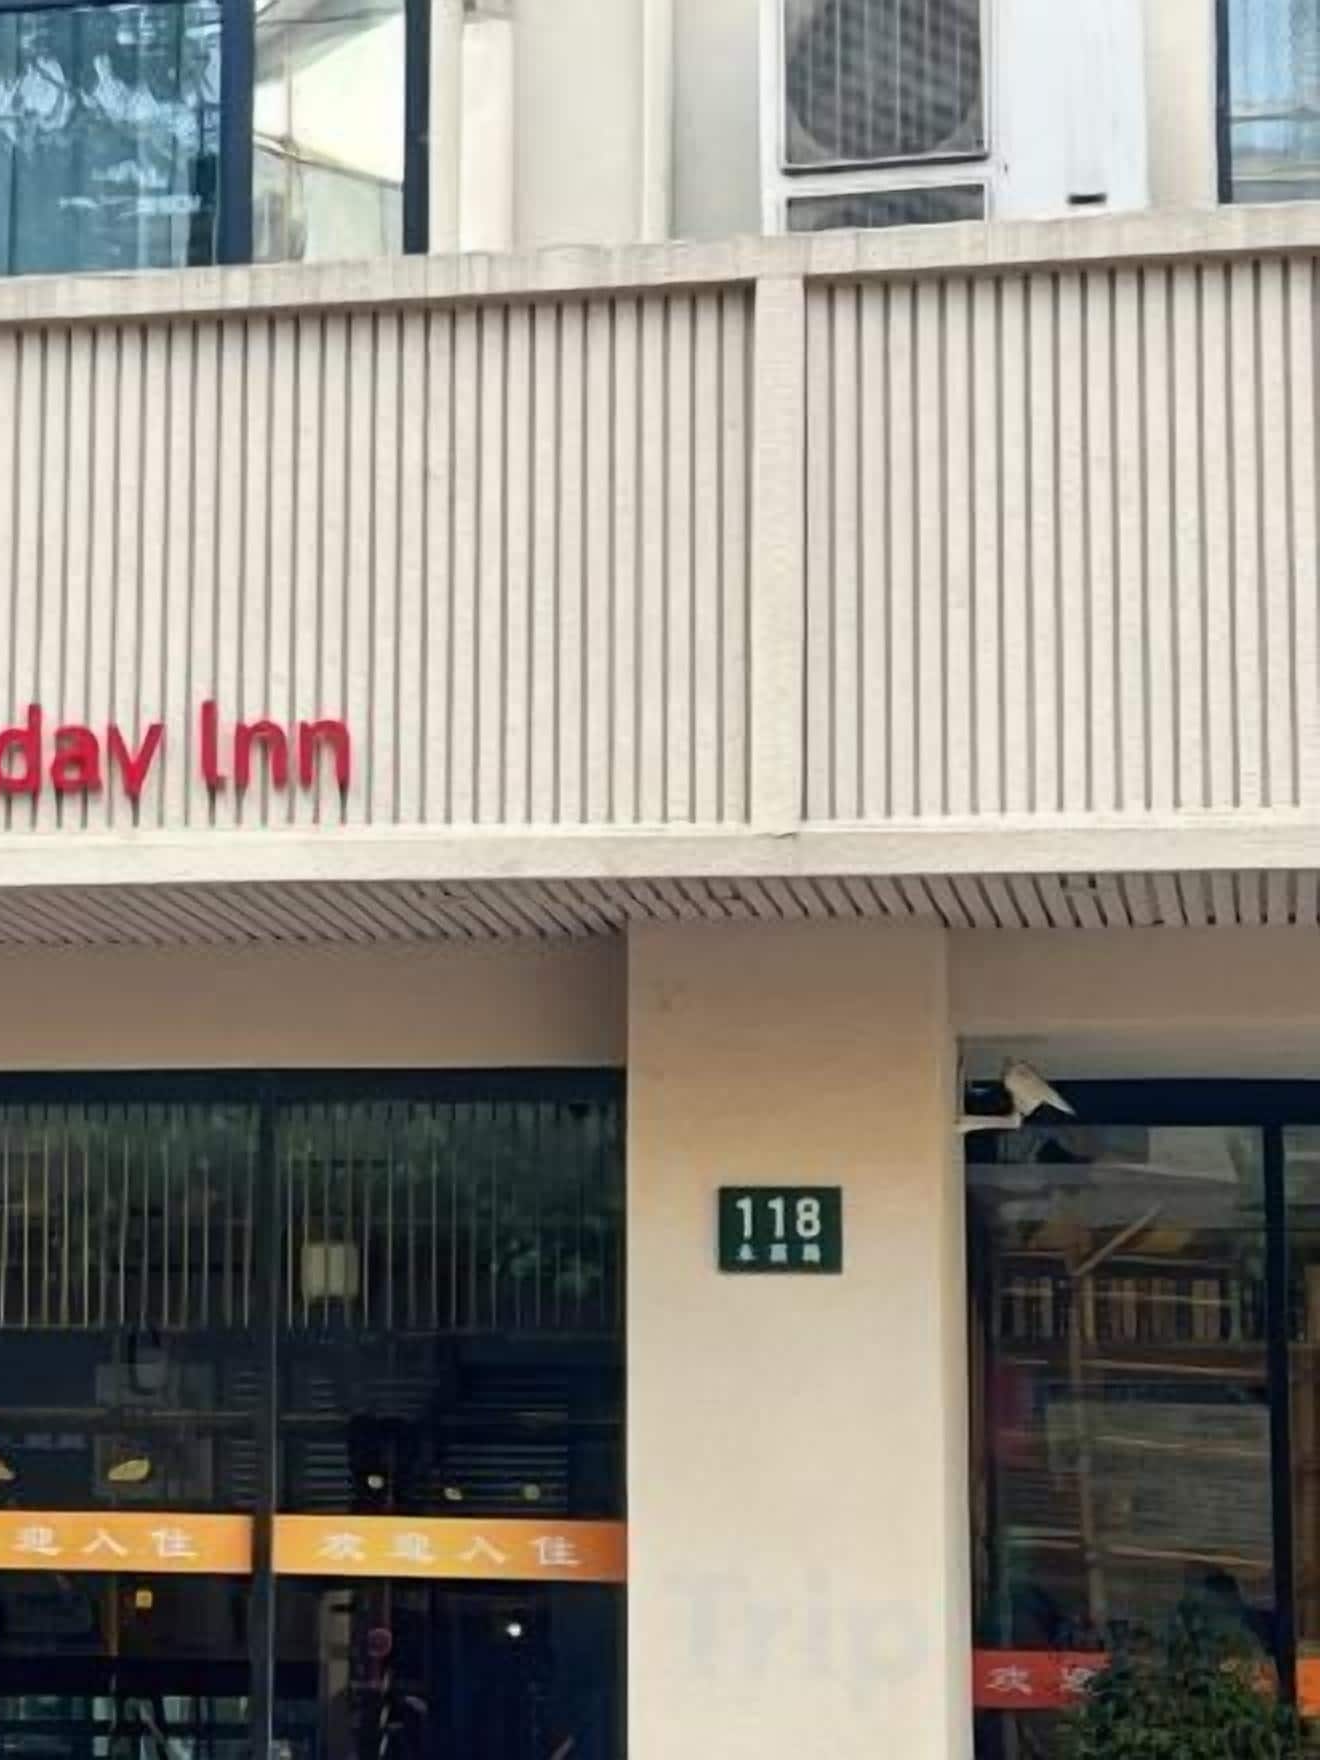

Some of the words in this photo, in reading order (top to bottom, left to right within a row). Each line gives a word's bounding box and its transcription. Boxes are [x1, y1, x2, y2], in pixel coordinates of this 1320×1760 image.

[736, 1196, 821, 1239] 118
[315, 1530, 581, 1566] 欢迎入住
